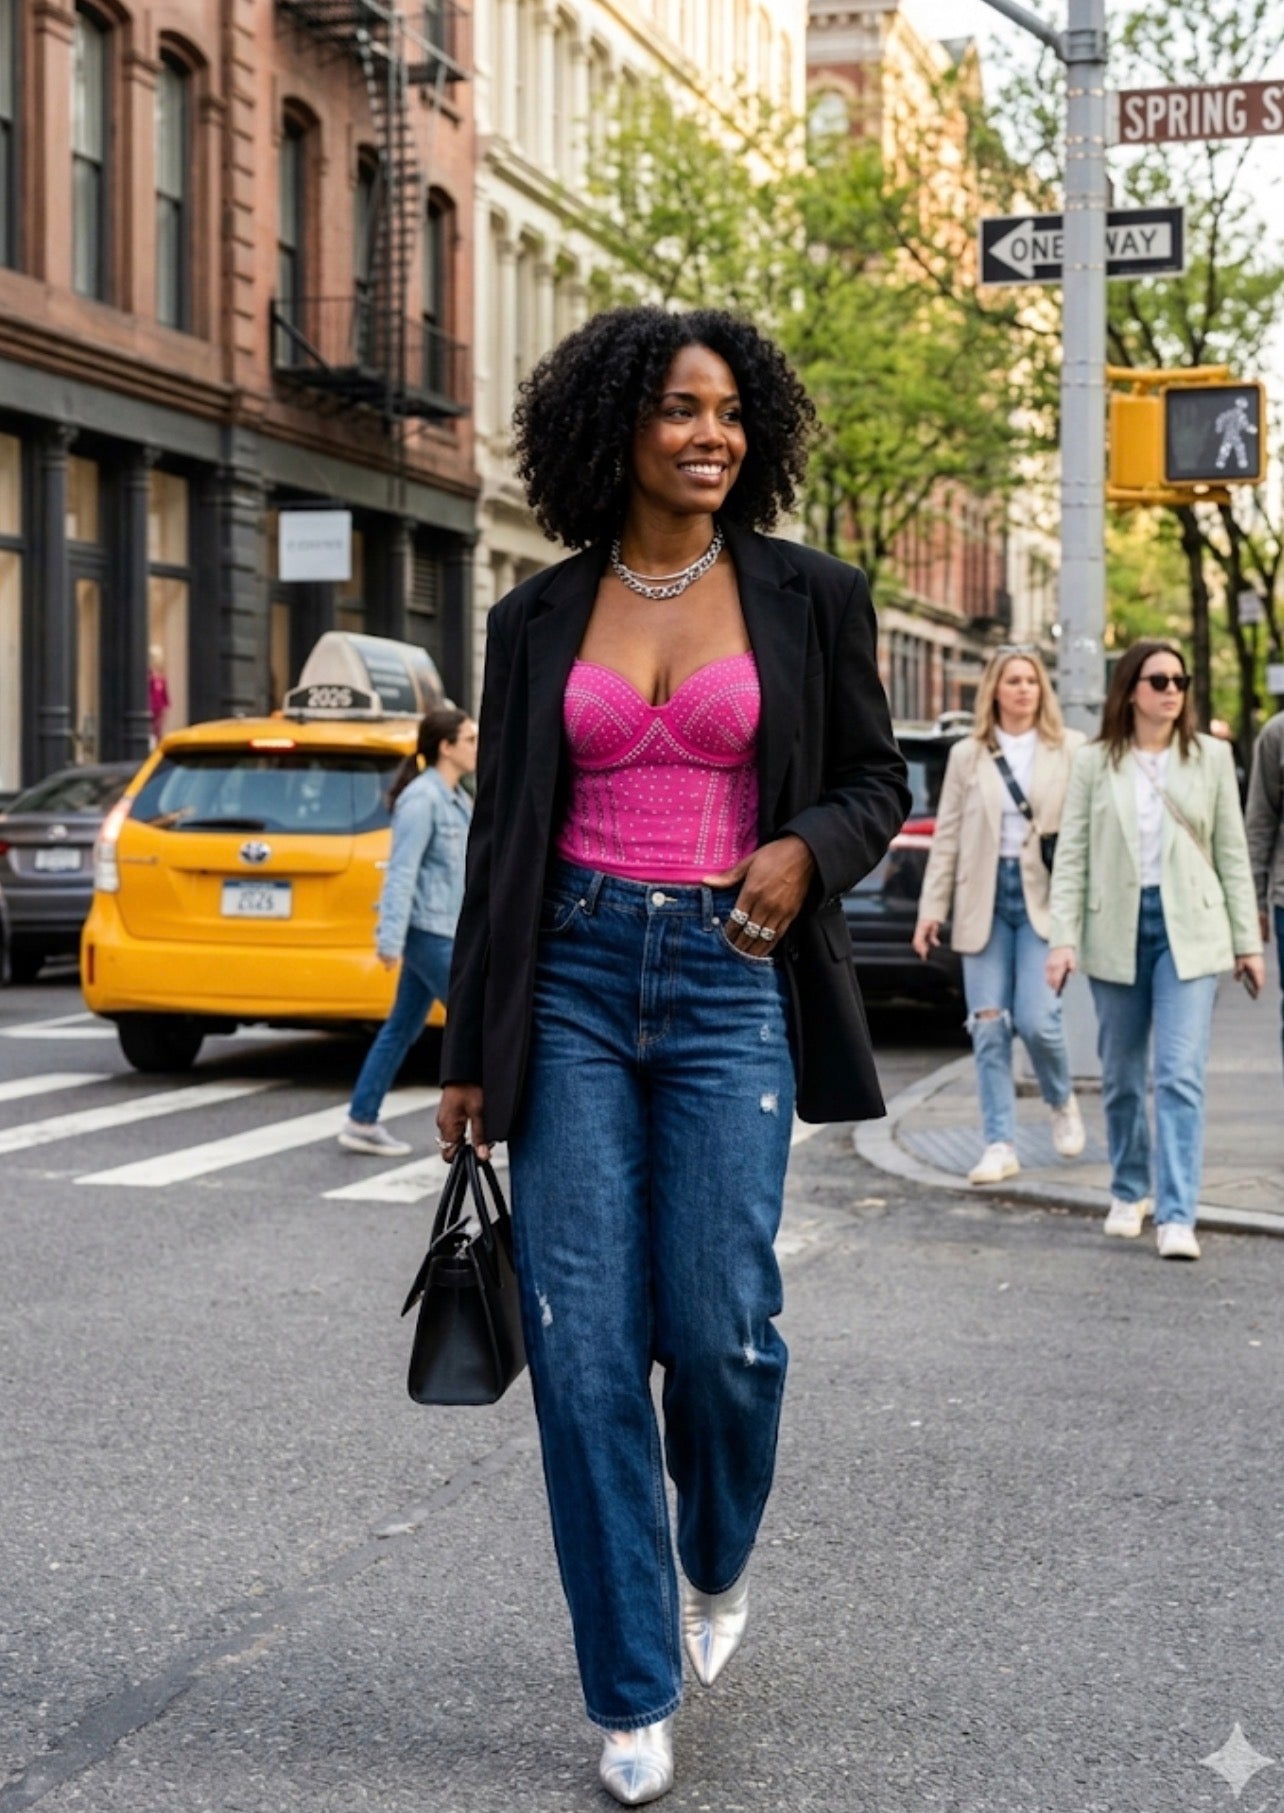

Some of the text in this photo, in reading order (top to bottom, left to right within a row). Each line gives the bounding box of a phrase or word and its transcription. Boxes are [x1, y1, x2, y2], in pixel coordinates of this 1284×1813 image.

[1124, 86, 1284, 140] SPRING S
[1011, 235, 1064, 262] ONE
